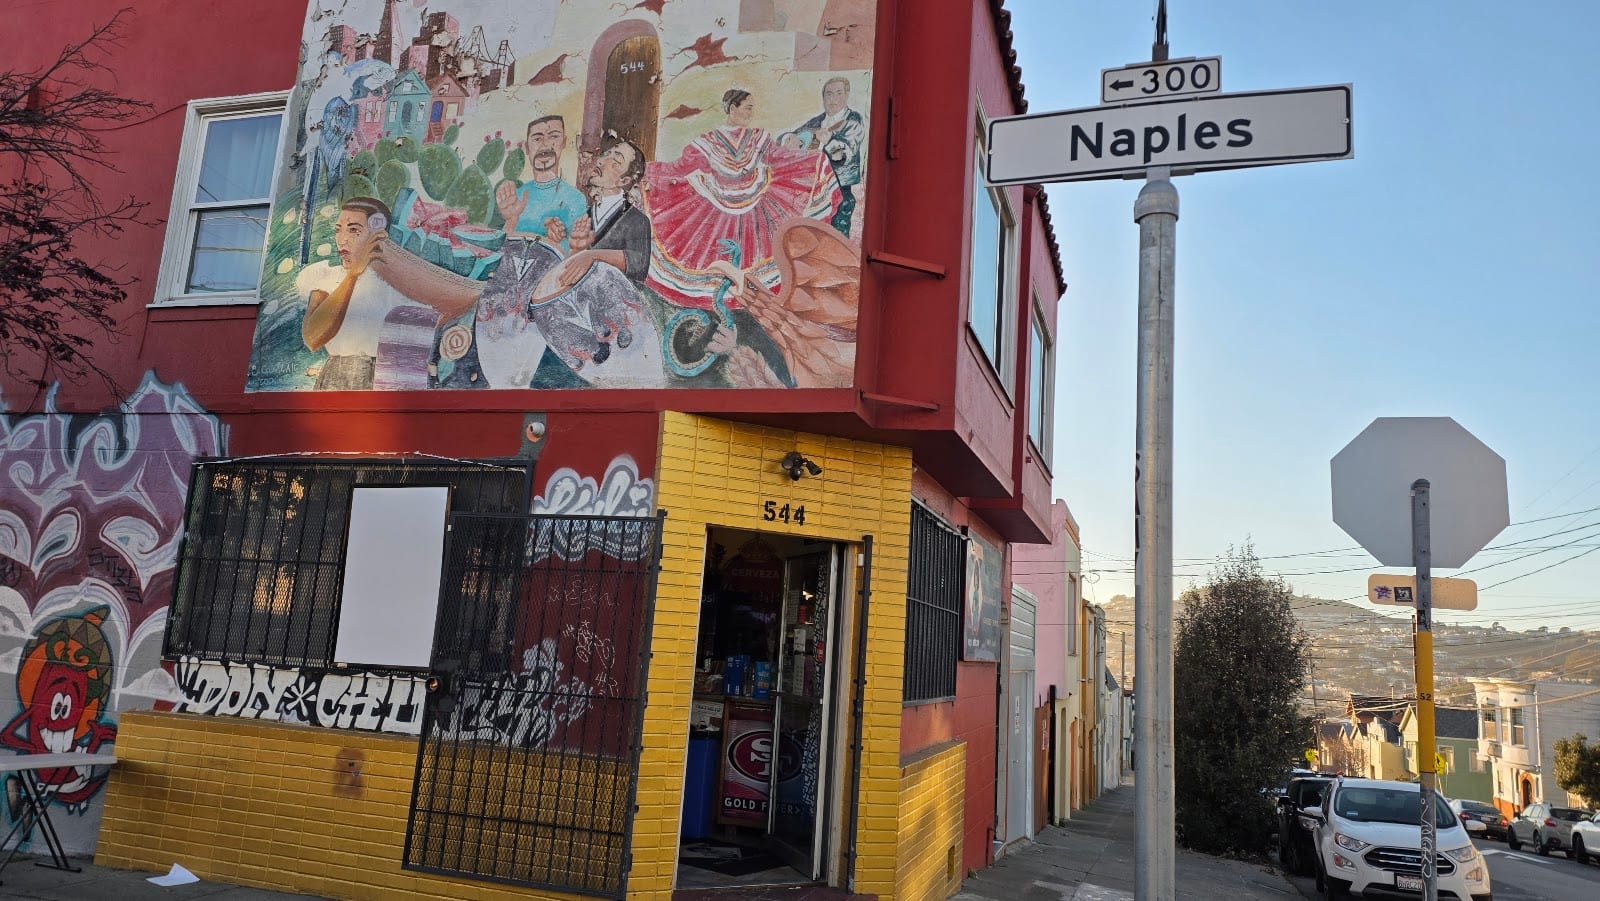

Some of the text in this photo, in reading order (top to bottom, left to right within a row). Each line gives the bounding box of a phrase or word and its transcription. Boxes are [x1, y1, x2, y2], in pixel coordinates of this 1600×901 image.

[620, 60, 645, 74] 544
[1141, 63, 1211, 94] 300
[1069, 113, 1254, 164] Naples
[763, 501, 806, 527] 544
[731, 567, 780, 579] CERVEZA
[1419, 692, 1431, 702] 52
[724, 797, 756, 810] GOLD
